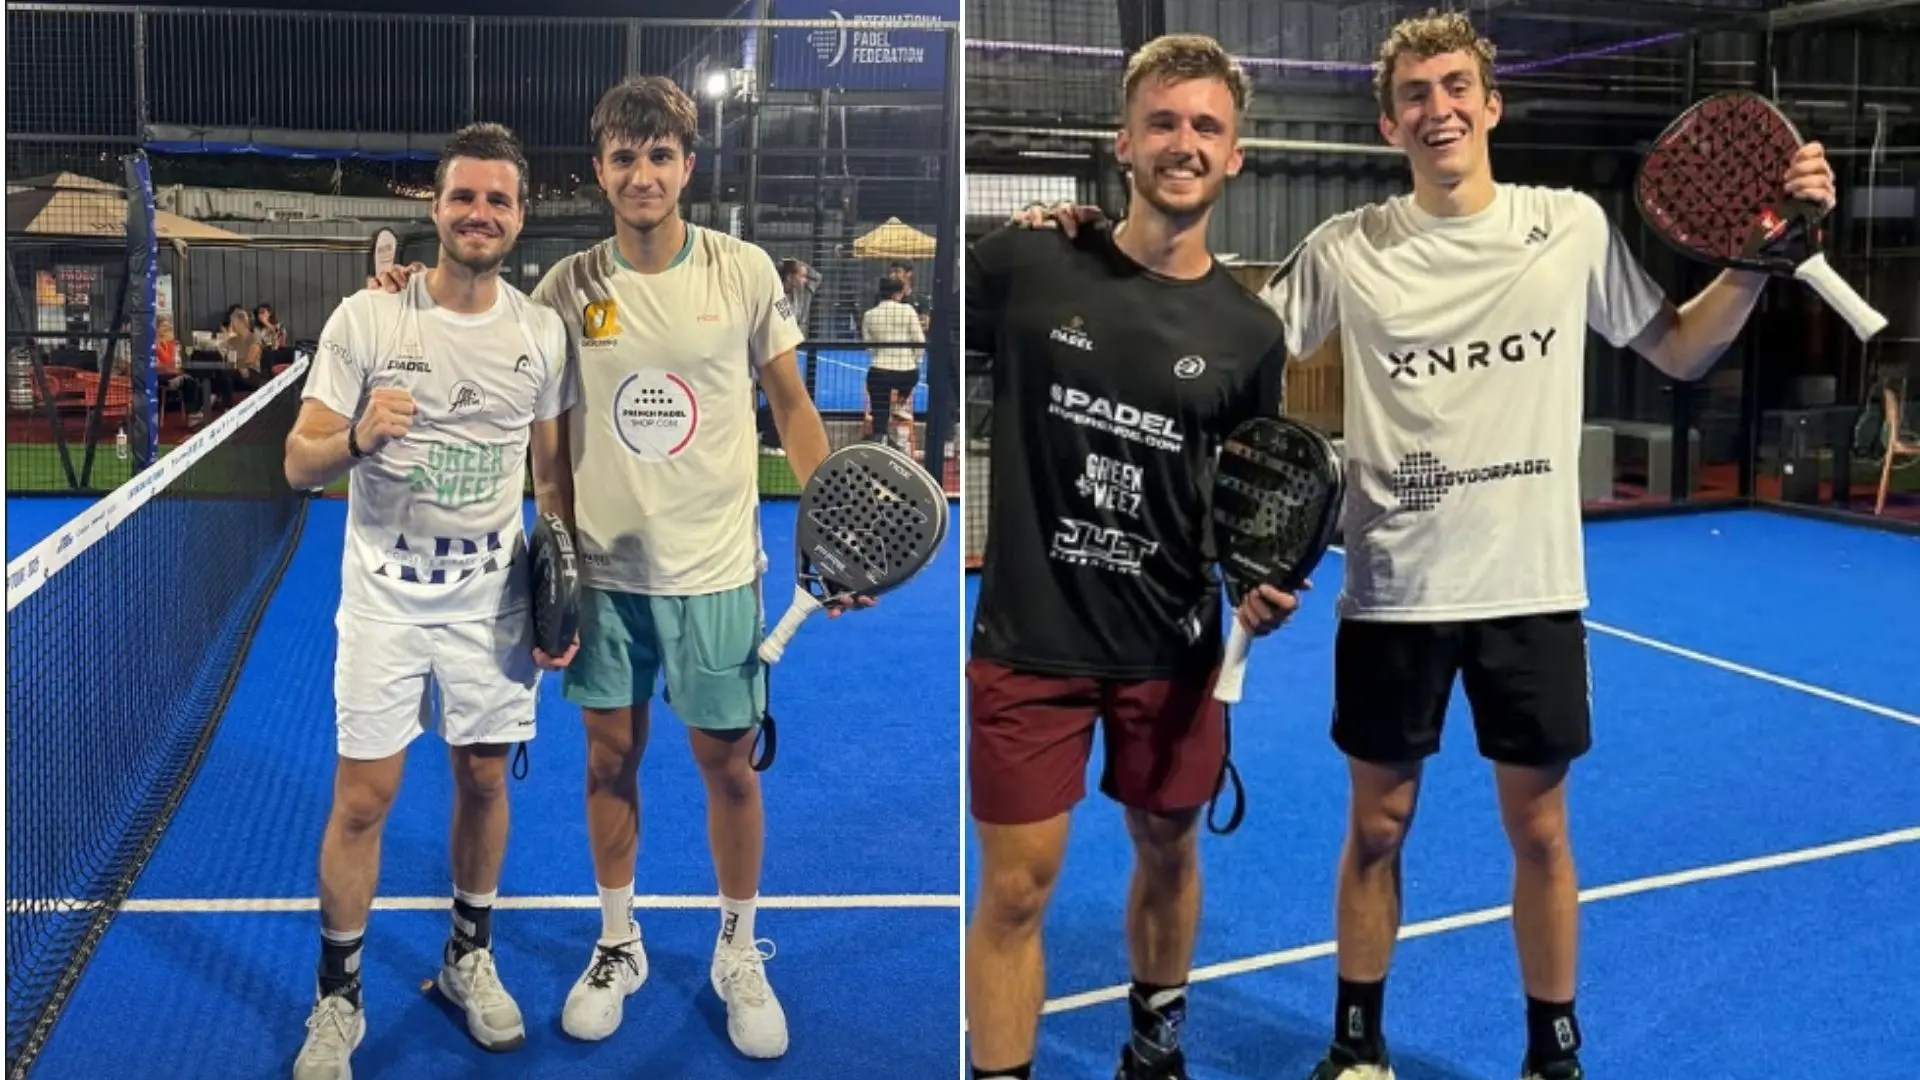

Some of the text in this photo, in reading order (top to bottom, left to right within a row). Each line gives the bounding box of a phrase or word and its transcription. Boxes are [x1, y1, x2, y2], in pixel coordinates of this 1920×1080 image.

[853, 31, 890, 47] PADEL
[853, 48, 924, 63] FEDERATION
[1388, 327, 1556, 379] XNRGY
[657, 410, 686, 418] PADEL
[1064, 387, 1184, 441] PADEL
[1086, 453, 1144, 493] GREEN
[1094, 482, 1141, 520] WEEZ
